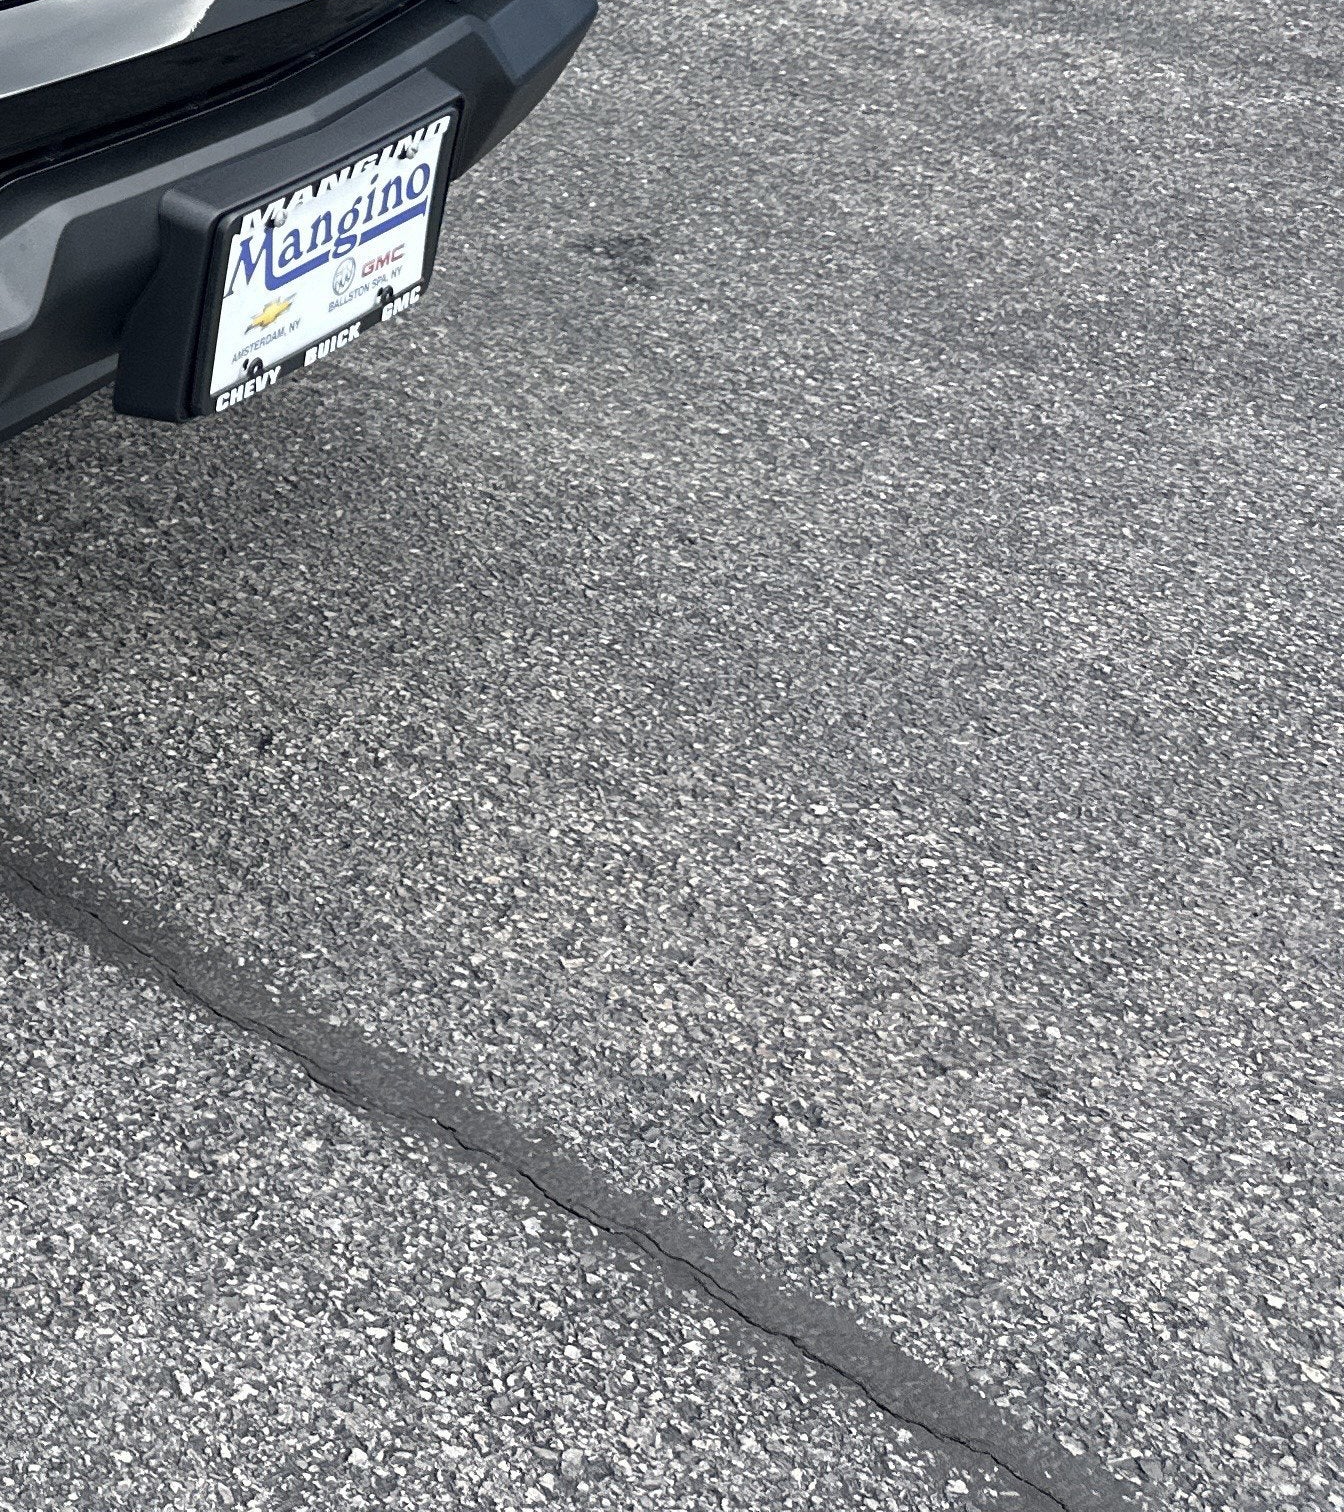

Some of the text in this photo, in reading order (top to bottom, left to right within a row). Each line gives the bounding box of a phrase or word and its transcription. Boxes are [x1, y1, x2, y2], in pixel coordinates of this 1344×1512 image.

[223, 162, 431, 296] Mangino
[361, 243, 405, 278] GMC
[328, 283, 370, 313] BALLSTON
[390, 264, 404, 278] NY
[216, 285, 422, 413] CHEVY BUICK GMC
[289, 317, 301, 333] NY
